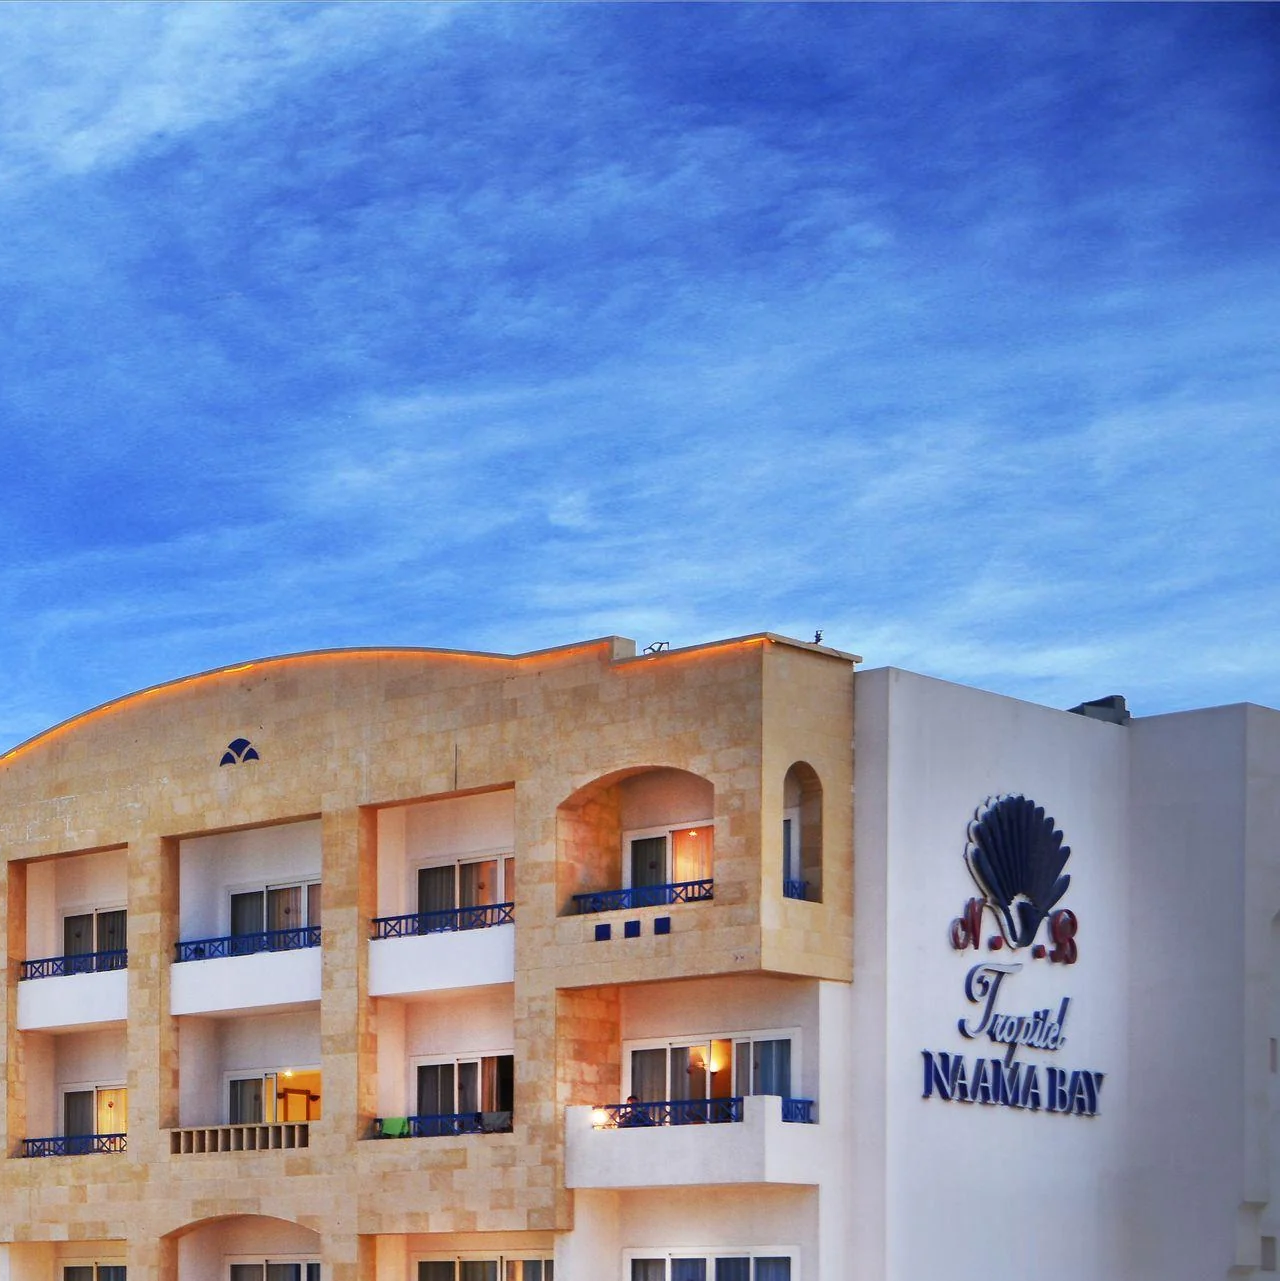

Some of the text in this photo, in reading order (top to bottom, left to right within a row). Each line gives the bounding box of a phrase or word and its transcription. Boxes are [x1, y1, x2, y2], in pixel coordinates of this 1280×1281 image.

[958, 962, 1072, 1068] Tropitel
[920, 1048, 1109, 1117] NAAMA BAY
